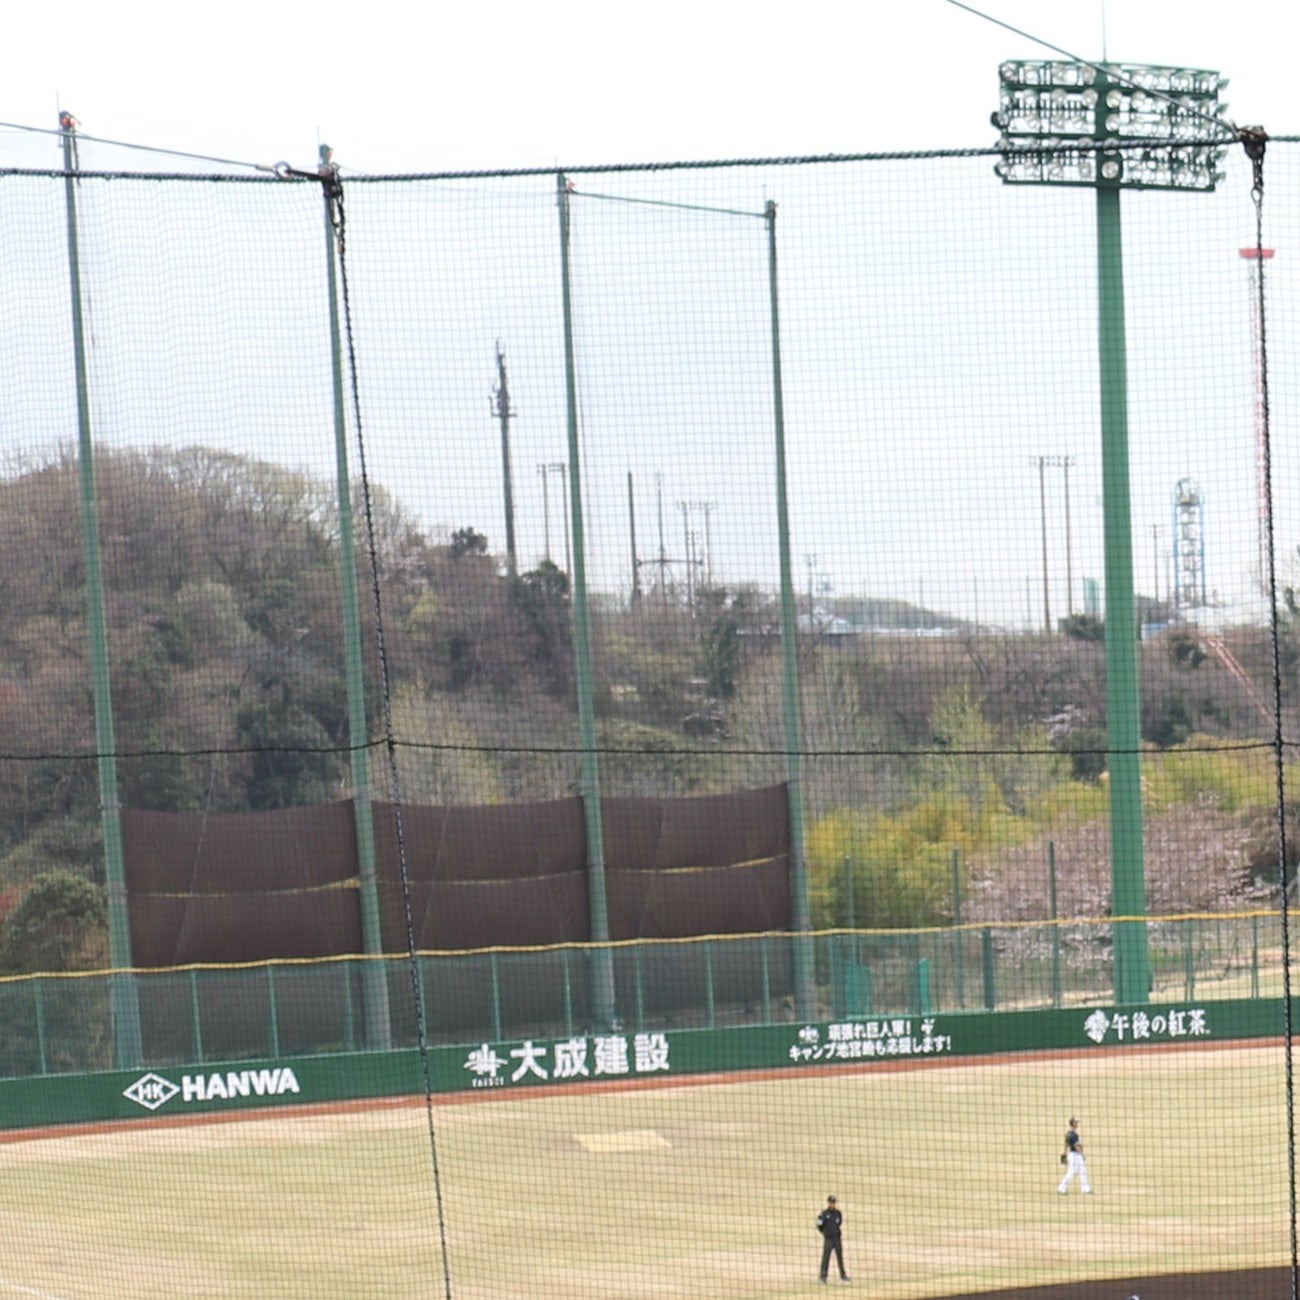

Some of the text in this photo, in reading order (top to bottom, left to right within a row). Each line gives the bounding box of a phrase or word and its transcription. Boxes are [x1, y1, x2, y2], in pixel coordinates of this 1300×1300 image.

[1111, 1009, 1206, 1041] 午後の紅茶
[510, 1033, 670, 1082] 大成建設
[138, 1083, 165, 1101] HK
[181, 1067, 300, 1102] HANWA
